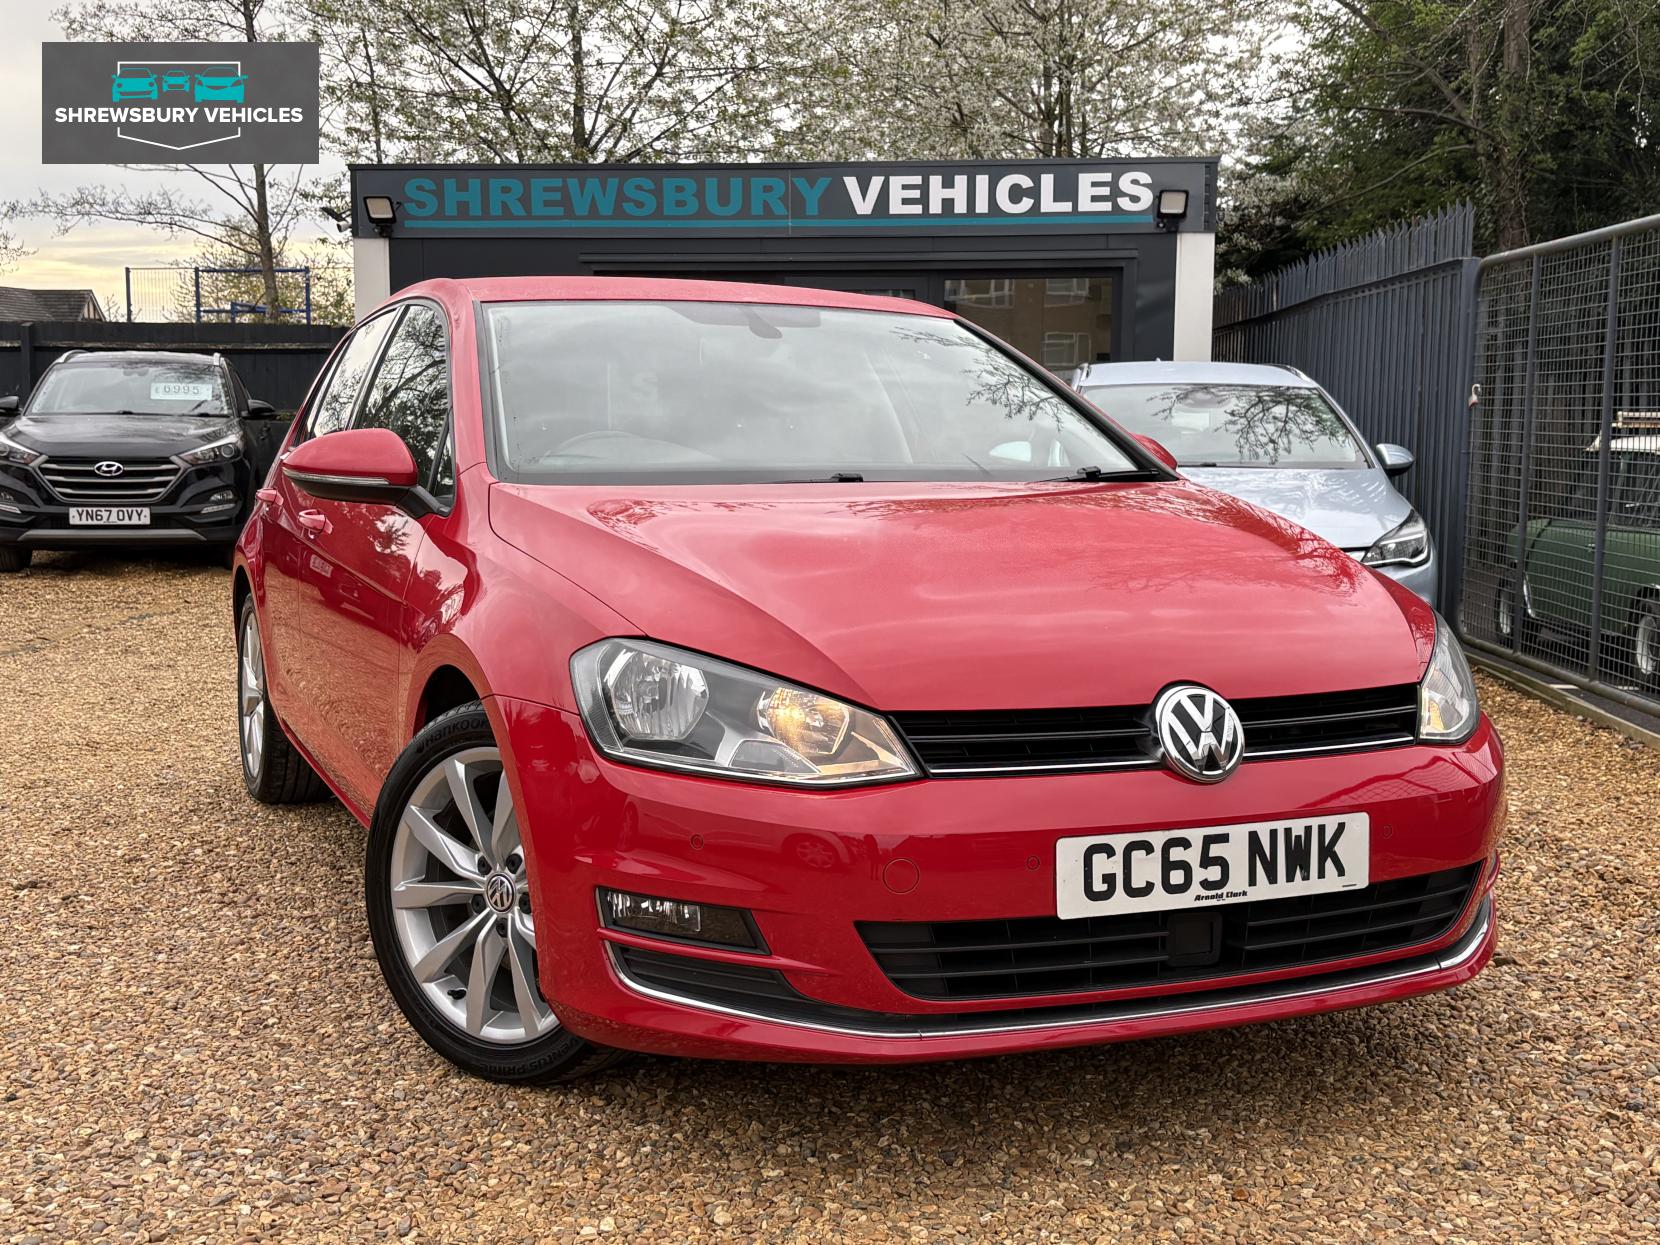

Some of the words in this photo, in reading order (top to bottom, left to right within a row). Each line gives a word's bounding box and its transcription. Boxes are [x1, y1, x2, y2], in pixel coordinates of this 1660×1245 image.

[404, 177, 832, 217] SHREWSBURY
[842, 171, 1154, 215] VEHICLES
[76, 509, 112, 522] YN67
[116, 509, 144, 522] OVY
[1083, 832, 1230, 902] GC65
[1247, 821, 1346, 887] NWK
[1194, 892, 1224, 902] Arnold
[1225, 890, 1248, 899] Clark
